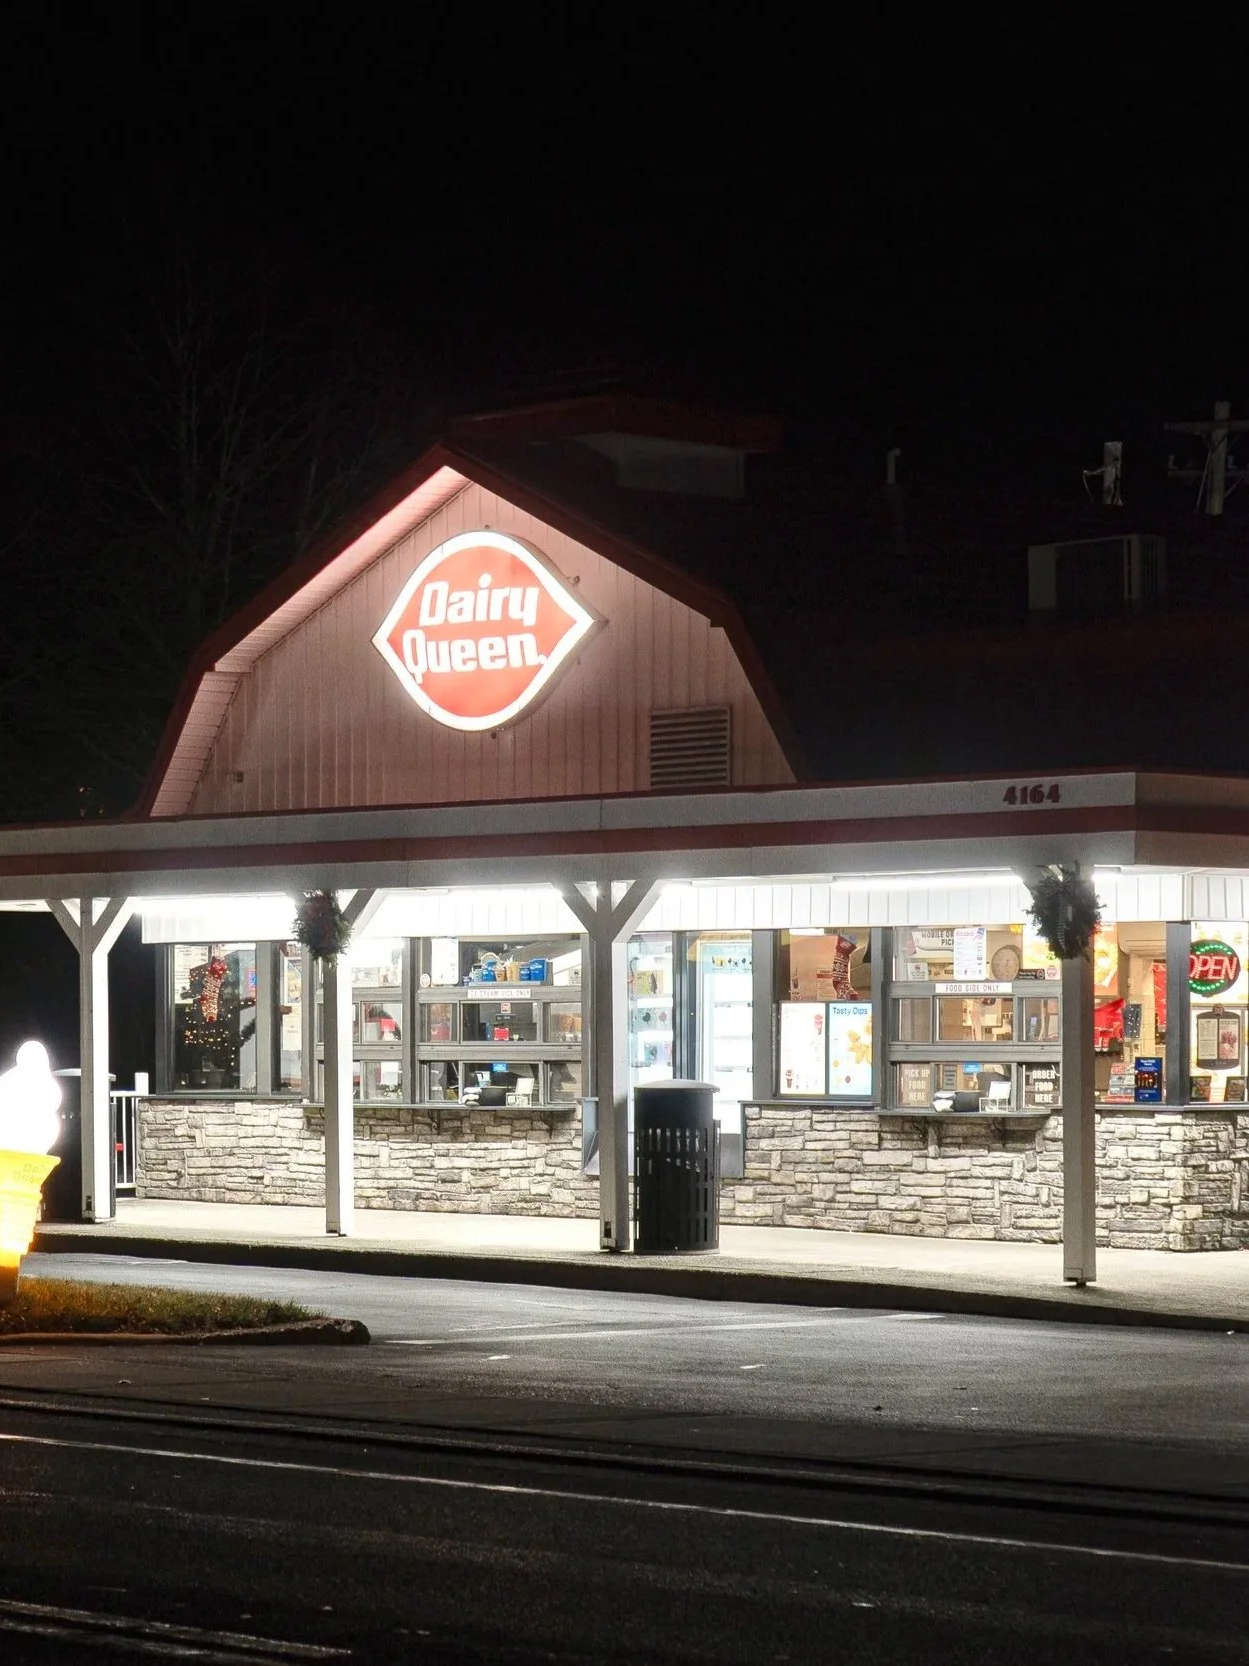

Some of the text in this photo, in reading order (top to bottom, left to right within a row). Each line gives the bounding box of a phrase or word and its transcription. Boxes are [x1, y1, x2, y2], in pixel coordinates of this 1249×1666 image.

[418, 572, 539, 627] Dairy
[402, 629, 539, 684] Queen
[1003, 784, 1061, 805] 4164
[945, 984, 999, 992] FOOD SIDE ONLY
[833, 1007, 868, 1015] Tasty Dips
[904, 1069, 930, 1078] PICK UP
[1032, 1070, 1056, 1079] ORDER
[908, 1081, 926, 1090] FOOD
[1034, 1082, 1054, 1091] FOOD
[908, 1092, 926, 1101] HERE
[1034, 1094, 1054, 1103] HERE
